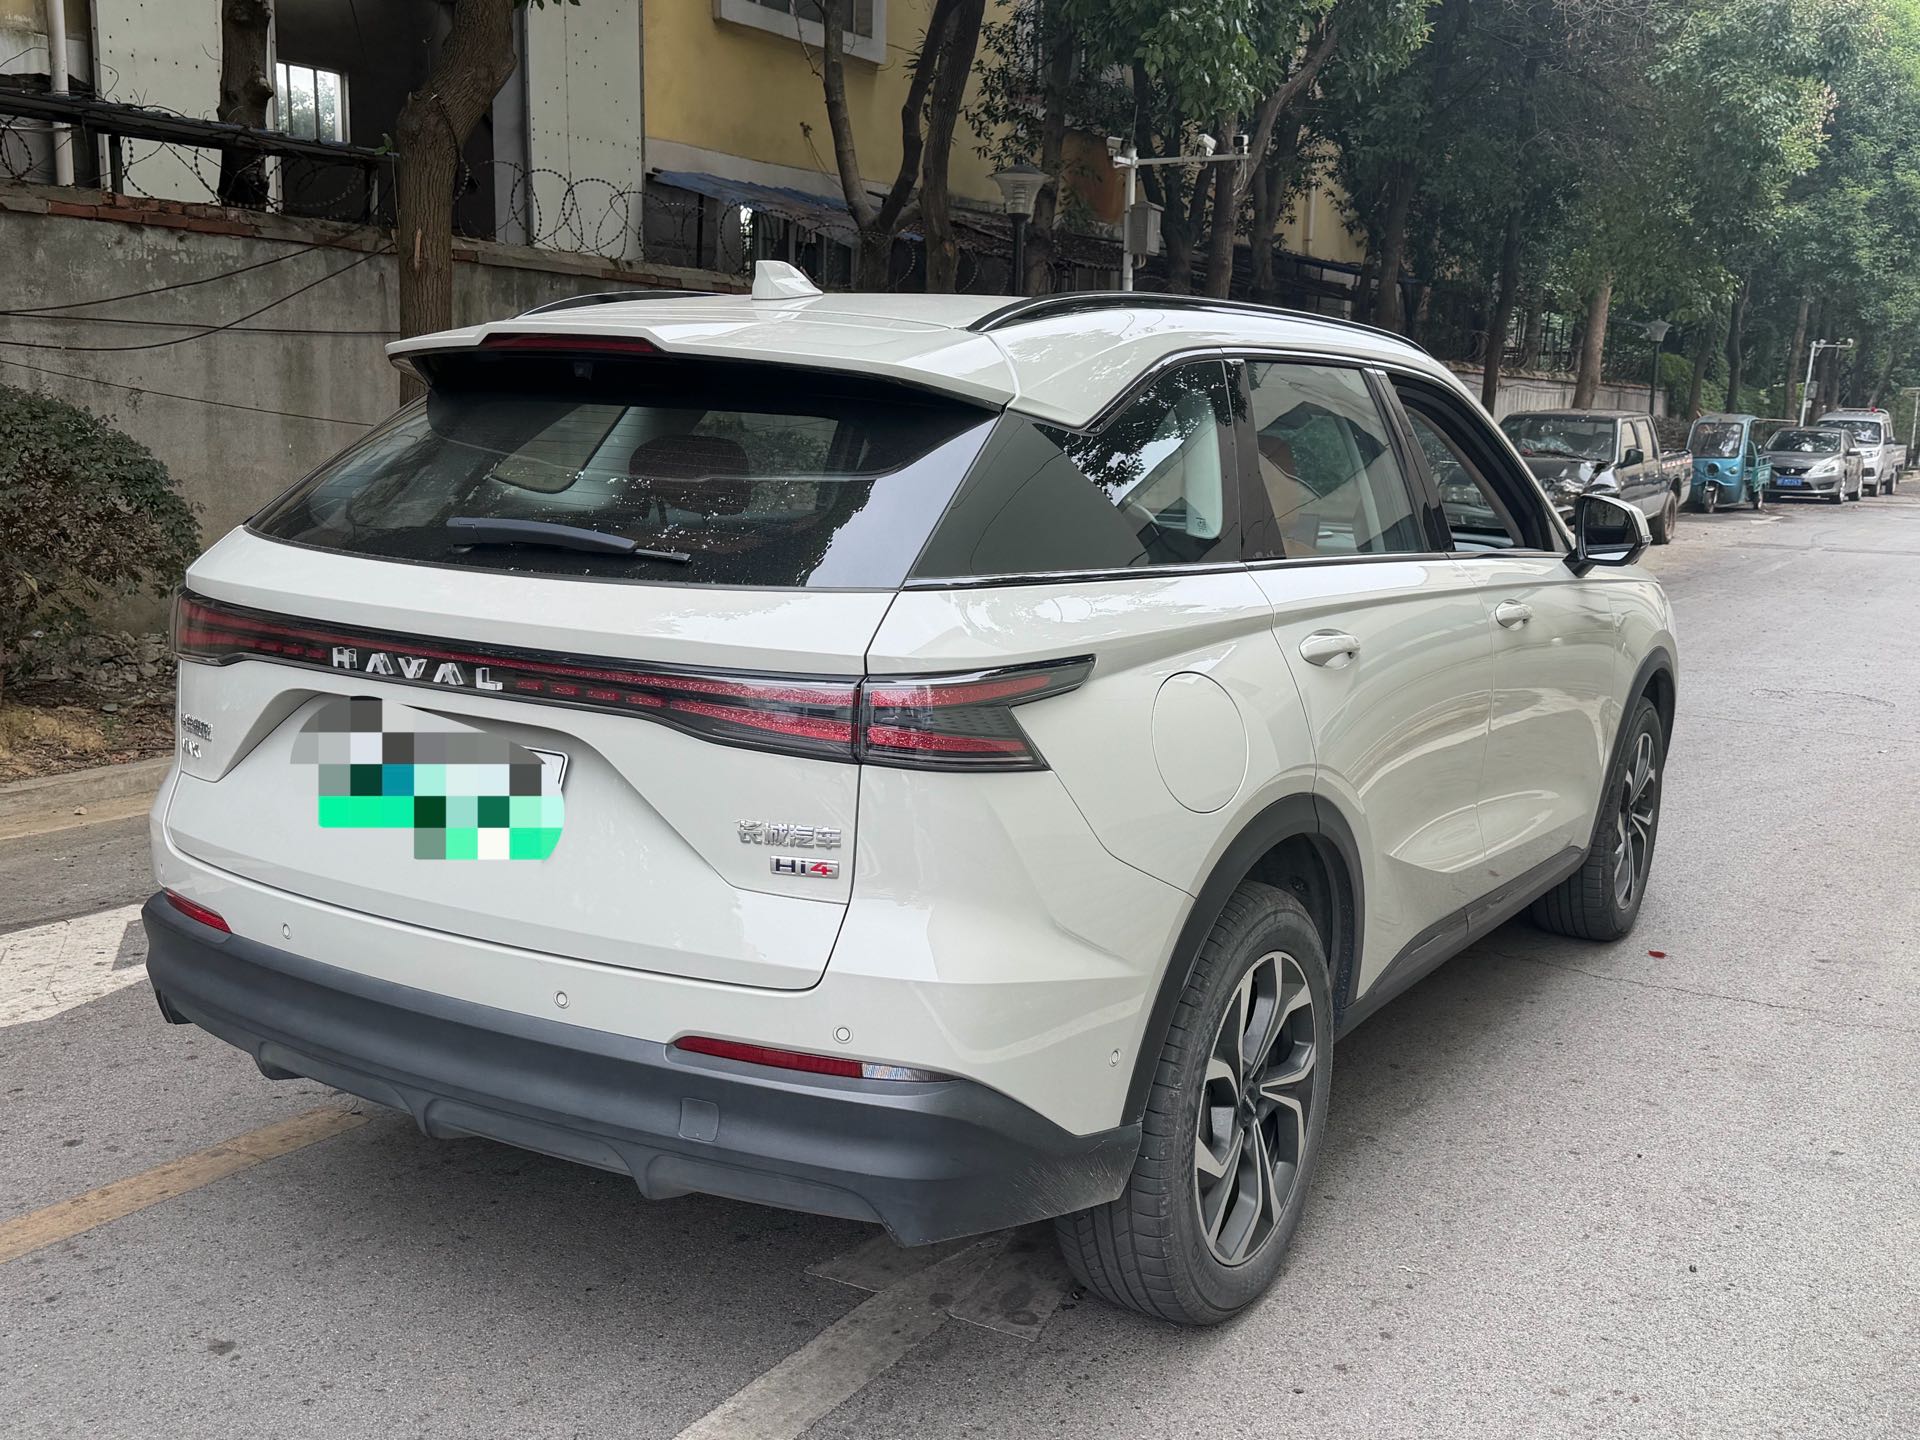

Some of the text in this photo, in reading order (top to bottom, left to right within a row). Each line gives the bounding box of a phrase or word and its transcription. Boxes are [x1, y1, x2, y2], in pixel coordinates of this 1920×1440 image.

[332, 646, 503, 691] HAVAL
[737, 819, 841, 849] 长城汽车
[775, 859, 833, 877] Hi4
